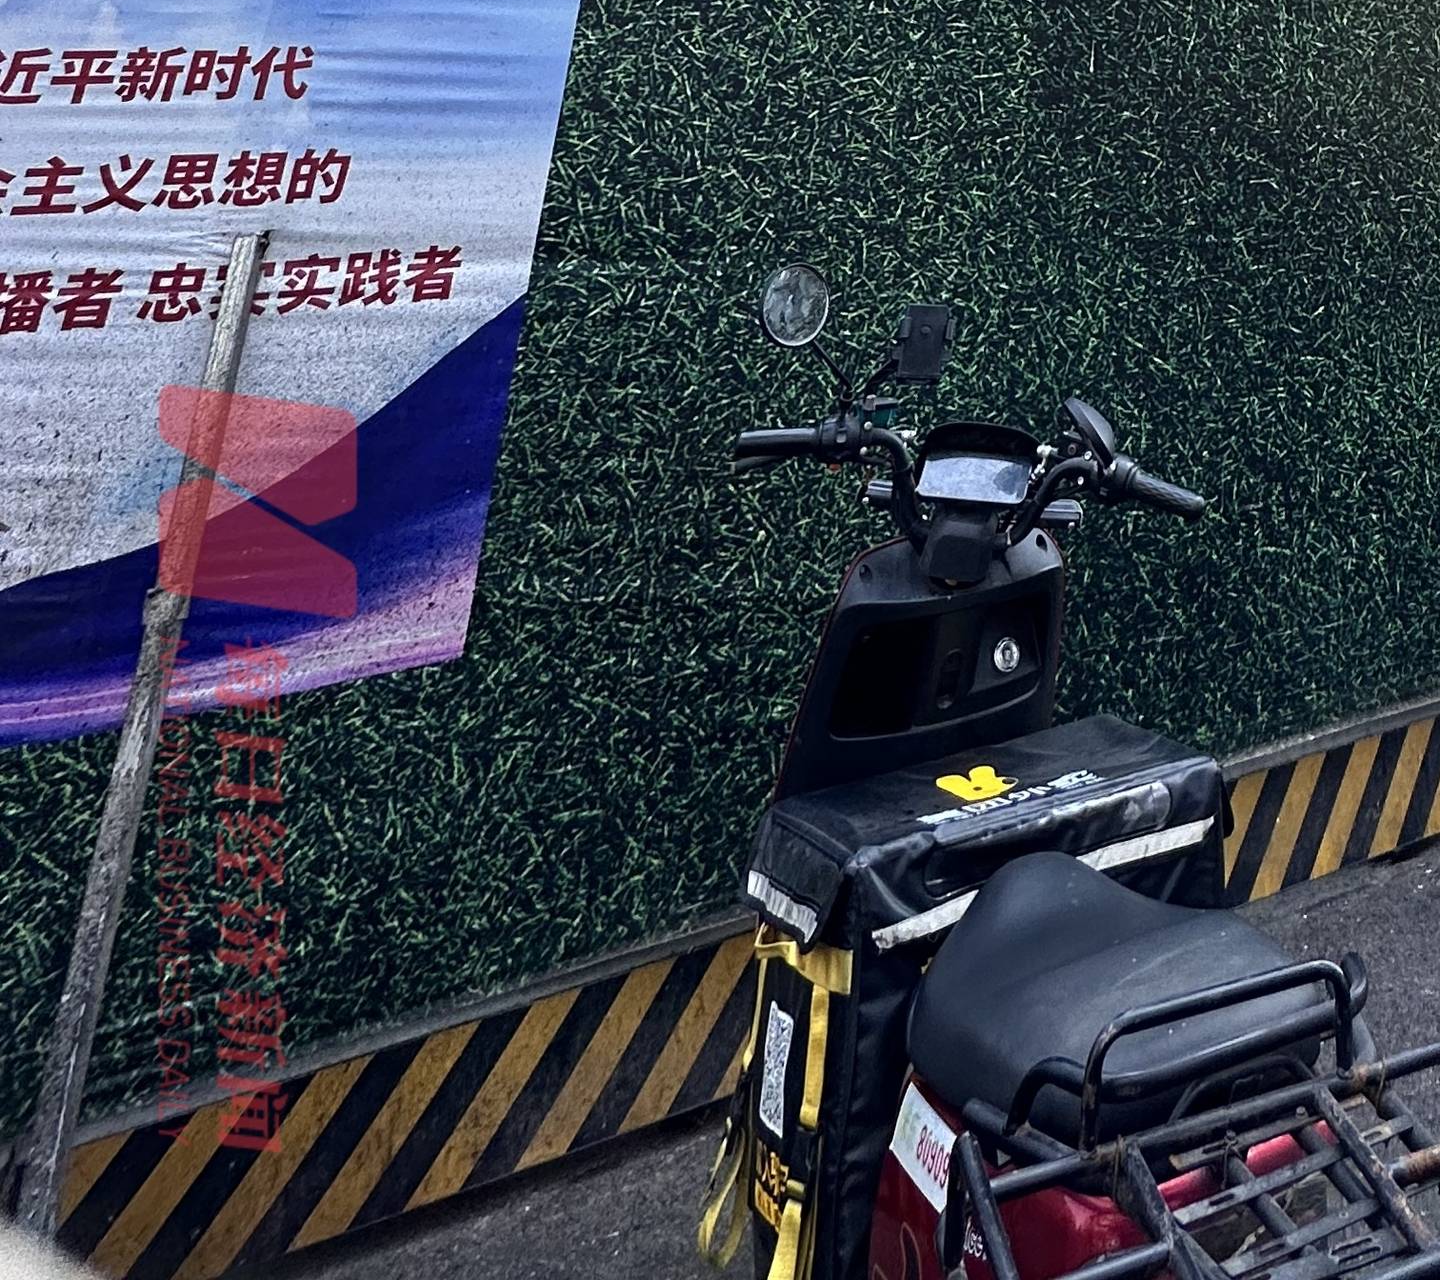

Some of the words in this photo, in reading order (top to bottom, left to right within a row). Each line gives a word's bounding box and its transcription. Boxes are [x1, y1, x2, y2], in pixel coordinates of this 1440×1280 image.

[0, 46, 315, 104] 近平新时代
